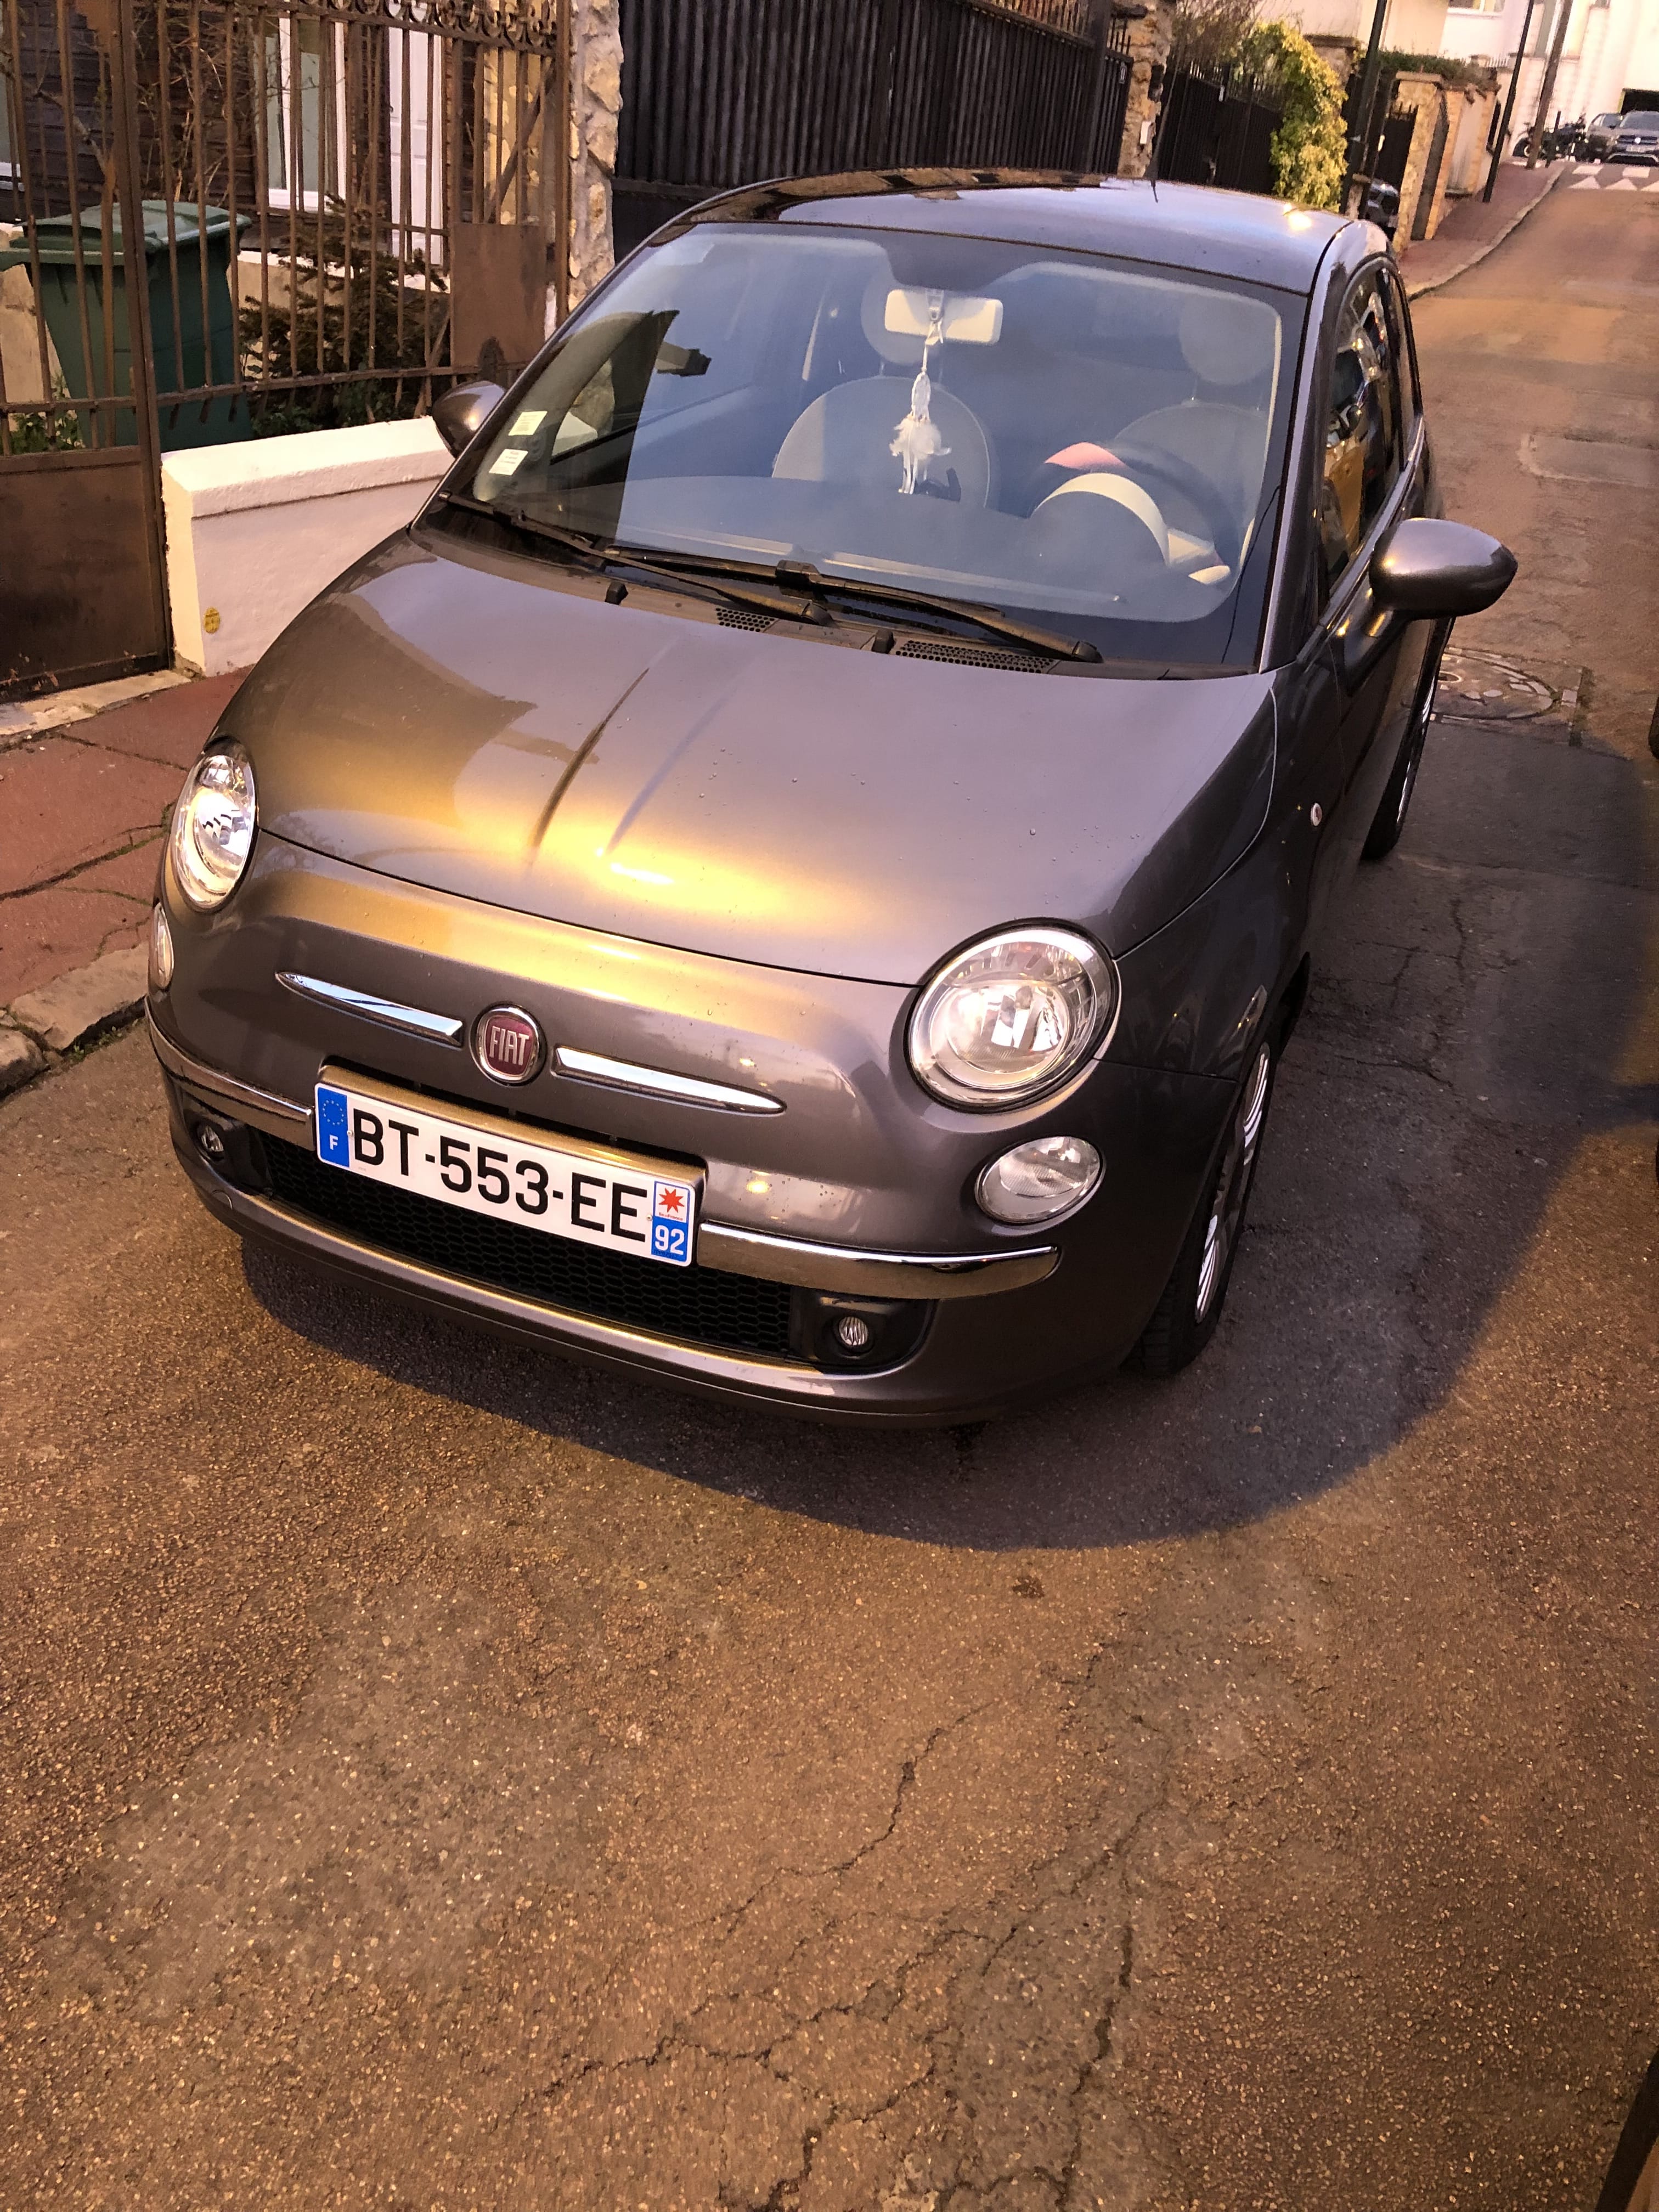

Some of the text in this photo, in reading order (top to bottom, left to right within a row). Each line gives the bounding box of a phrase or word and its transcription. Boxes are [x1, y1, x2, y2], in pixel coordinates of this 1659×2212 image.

[489, 1025, 529, 1066] FIAT
[329, 1134, 338, 1150] F
[353, 1108, 647, 1243] BT-553-EE
[654, 1224, 685, 1256] 92
